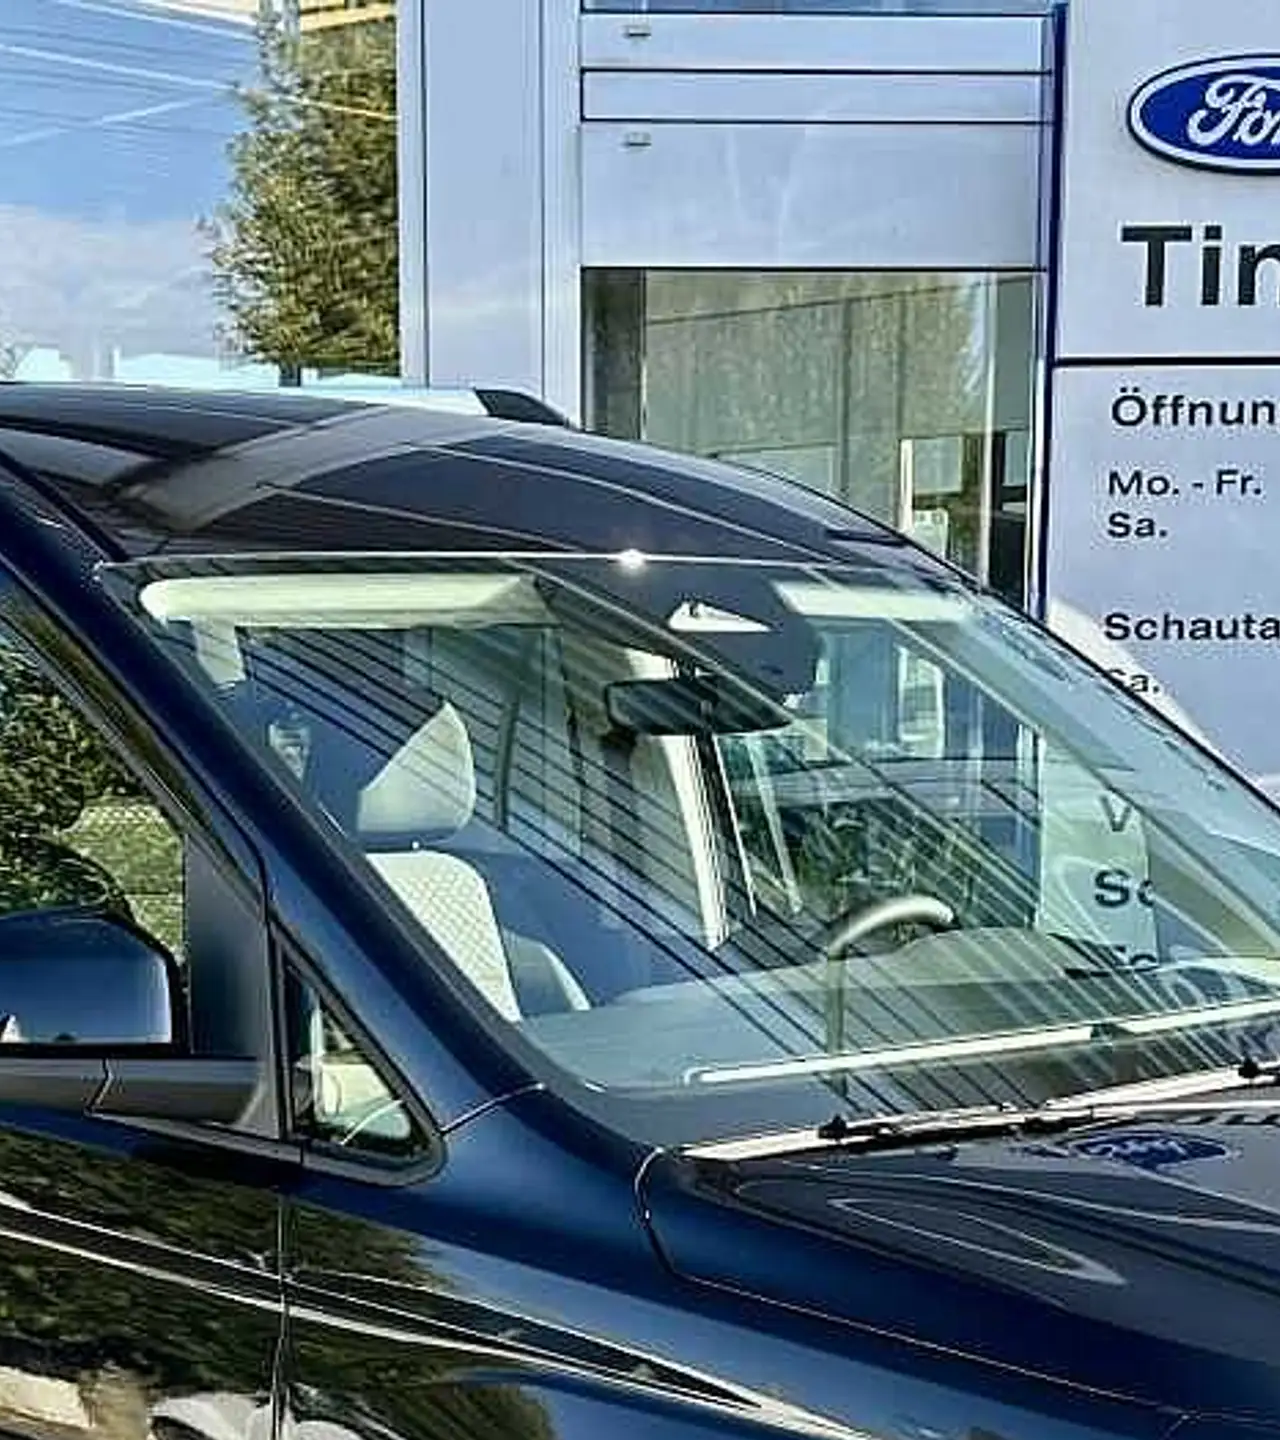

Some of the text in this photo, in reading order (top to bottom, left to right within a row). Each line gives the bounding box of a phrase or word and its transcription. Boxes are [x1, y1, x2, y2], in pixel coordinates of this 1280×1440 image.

[1108, 469, 1180, 497] Mo.
[1216, 468, 1262, 496] Fr.
[1107, 511, 1168, 538] Sa.
